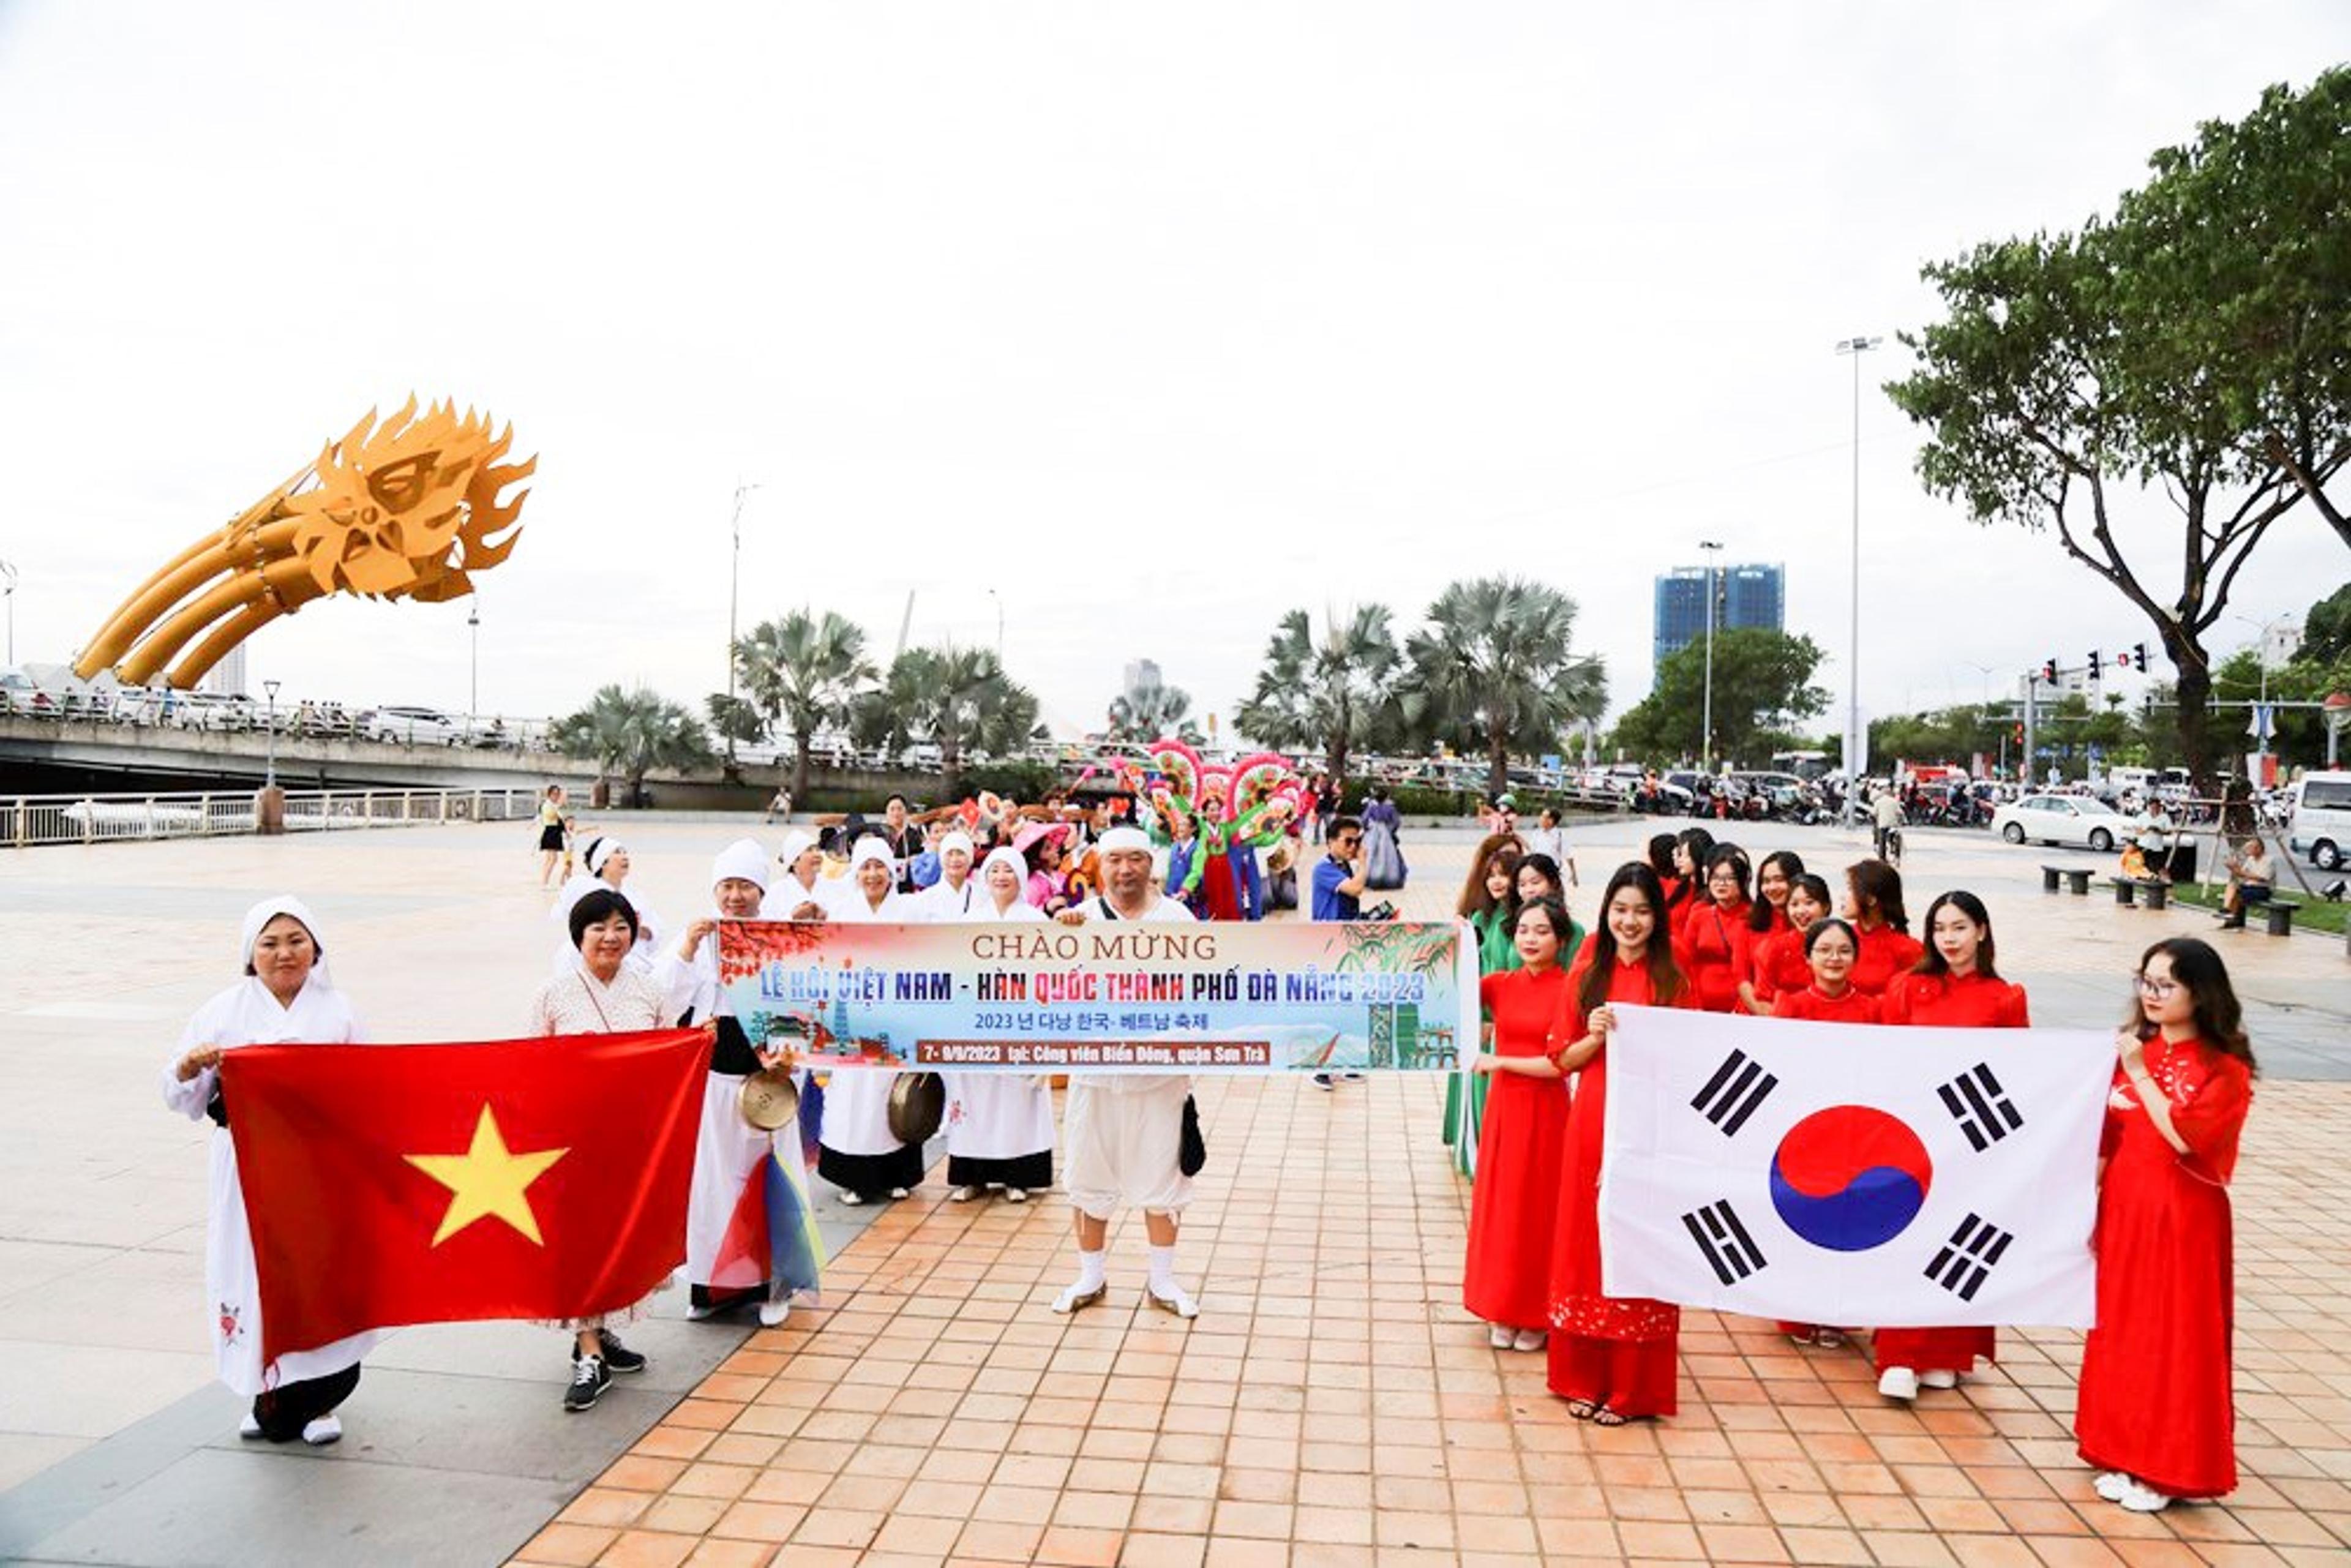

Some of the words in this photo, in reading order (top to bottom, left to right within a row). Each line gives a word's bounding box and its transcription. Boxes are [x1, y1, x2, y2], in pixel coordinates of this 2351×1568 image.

[973, 929, 1079, 959] CHÀO
[1092, 929, 1217, 960] MỪNG
[839, 966, 887, 1007] VIỆT
[896, 972, 951, 1000] NAM
[977, 966, 1027, 1000] HÀN
[1035, 964, 1097, 1003] QUỐC
[1106, 967, 1183, 1001] THÀNH
[1192, 964, 1240, 1000] PHỐ
[1247, 968, 1277, 1000] ĐÀ
[1362, 973, 1424, 1000] 2023
[975, 1013, 1013, 1029] 2023
[1018, 1013, 1033, 1030] 년
[1040, 1013, 1071, 1030] 다낭
[1120, 1013, 1170, 1031] 베트남
[1175, 1012, 1209, 1030] 축제
[1033, 1045, 1068, 1063] Công
[1071, 1045, 1100, 1062] viên
[1102, 1043, 1133, 1062] Biển
[1177, 1046, 1212, 1065] quận
[1214, 1045, 1240, 1062] Sơn
[1243, 1045, 1265, 1062] Trà
